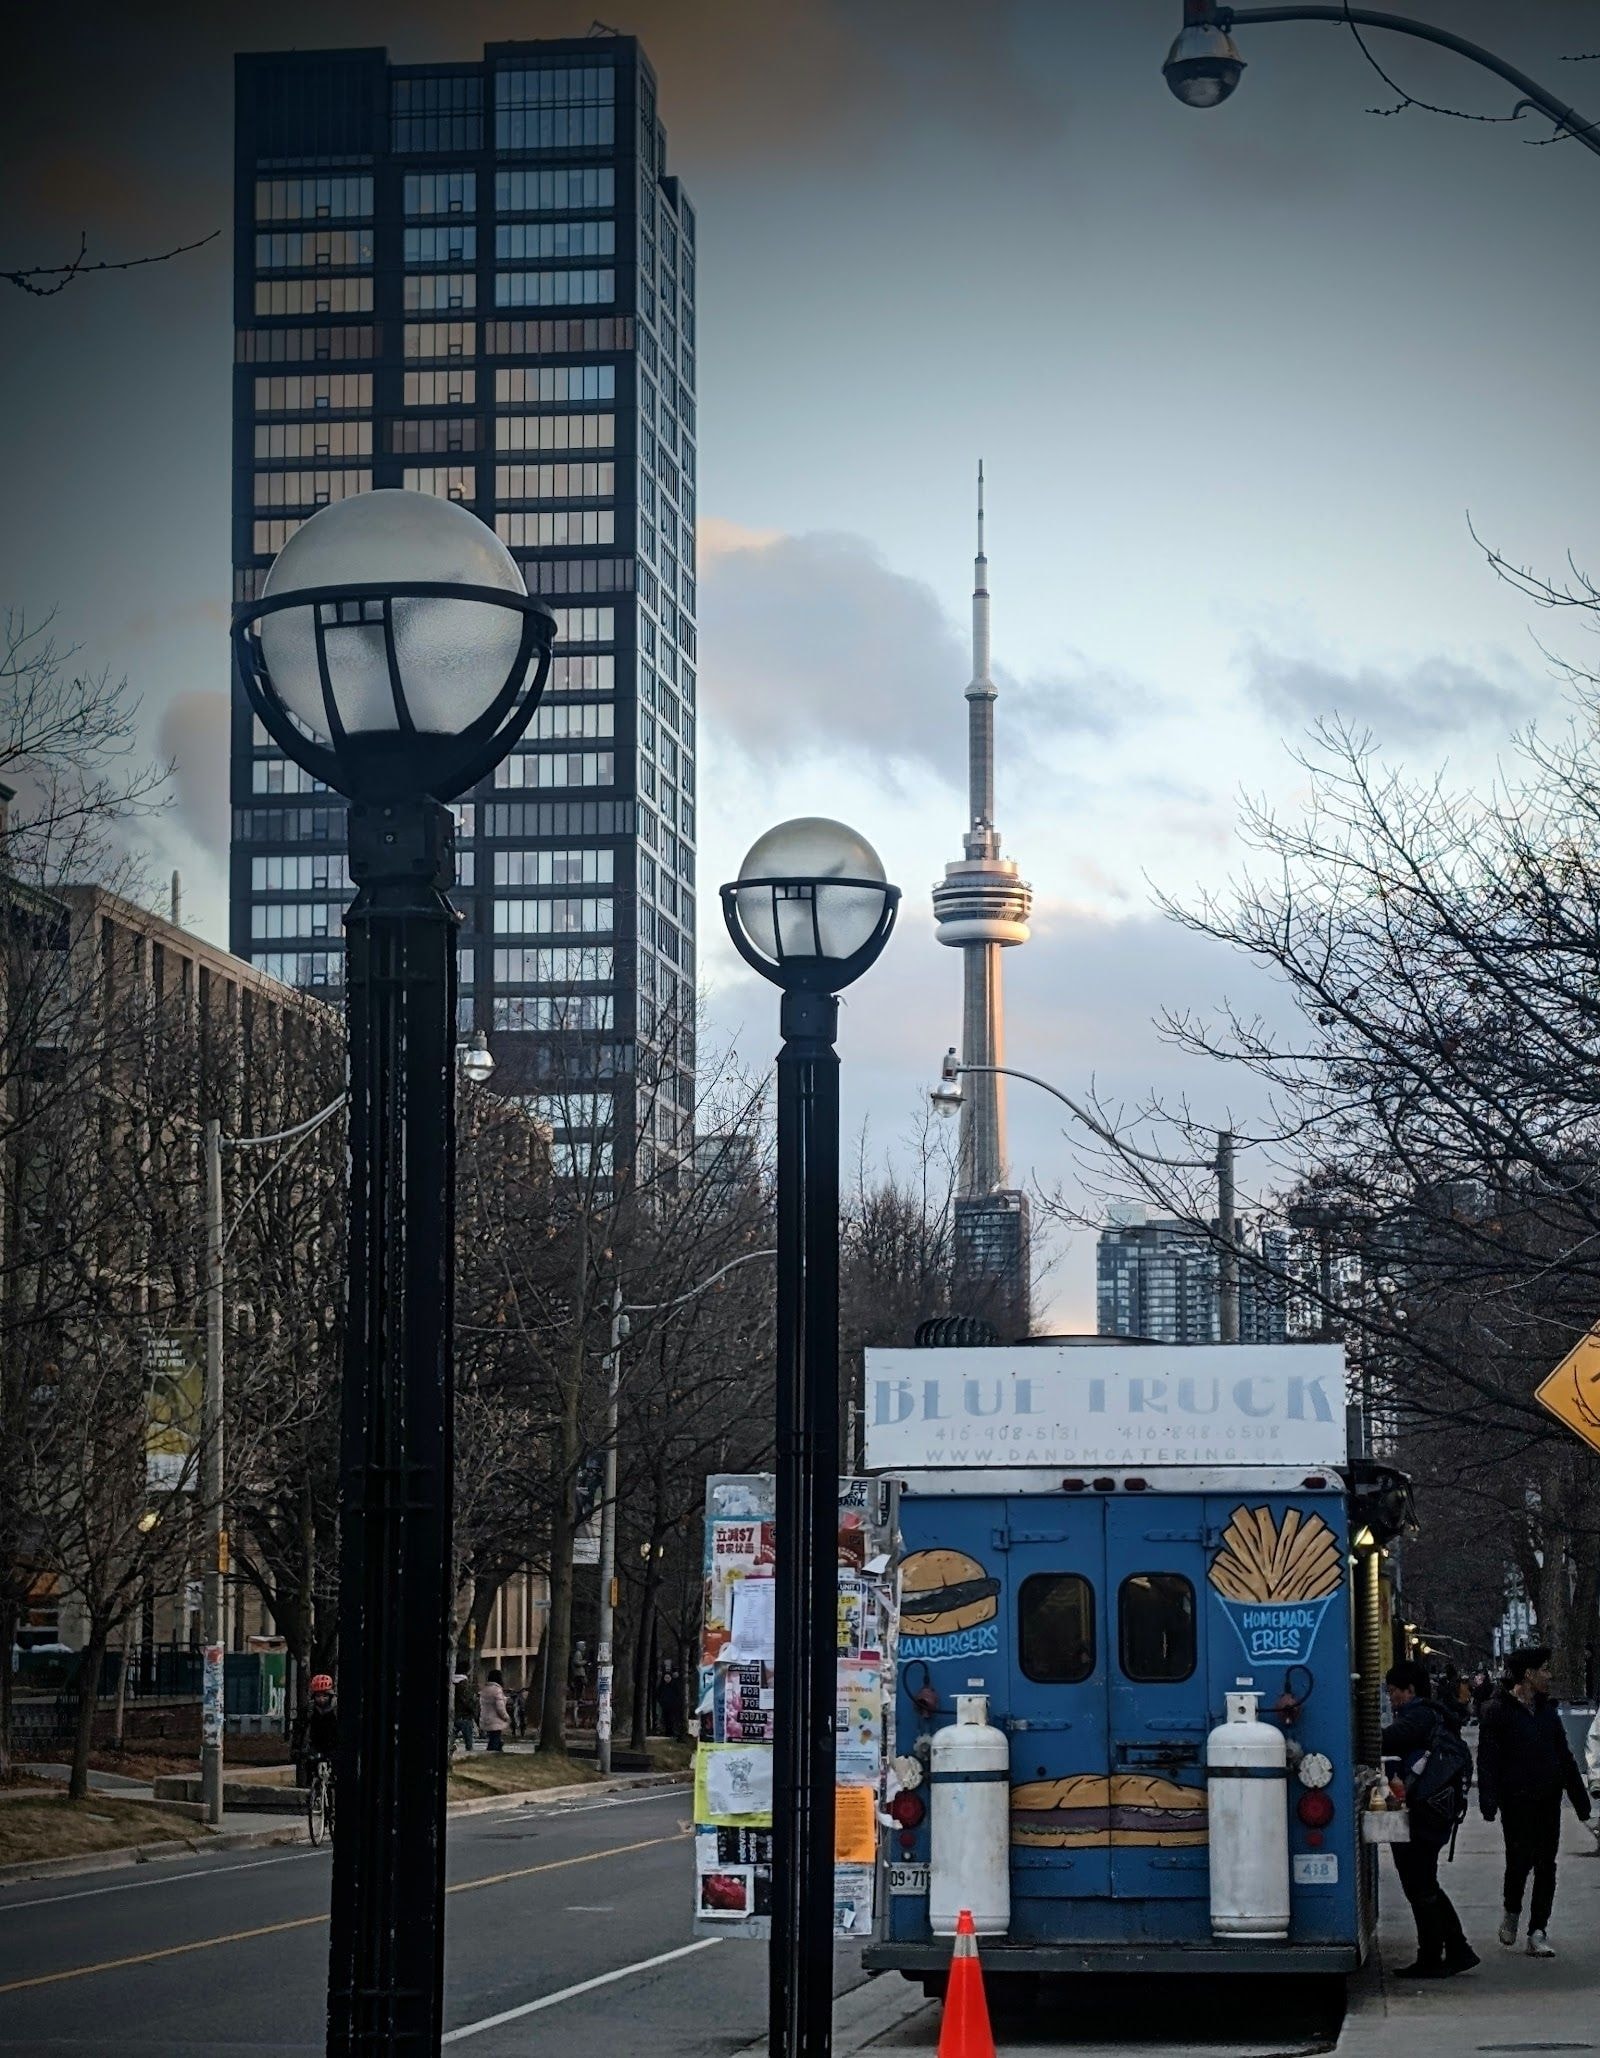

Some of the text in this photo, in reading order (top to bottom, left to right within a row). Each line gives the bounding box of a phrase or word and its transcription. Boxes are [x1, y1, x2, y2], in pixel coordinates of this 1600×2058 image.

[871, 1374, 1336, 1427] BLUE TRUCK
[847, 1490, 865, 1499] EST
[1242, 1609, 1315, 1629] HOMEMADE
[897, 1625, 998, 1657] HAMBURGERS
[1251, 1628, 1301, 1651] FRIES
[740, 1673, 760, 1683] EQU
[742, 1687, 759, 1695] WOR
[739, 1712, 765, 1721] EQUAL
